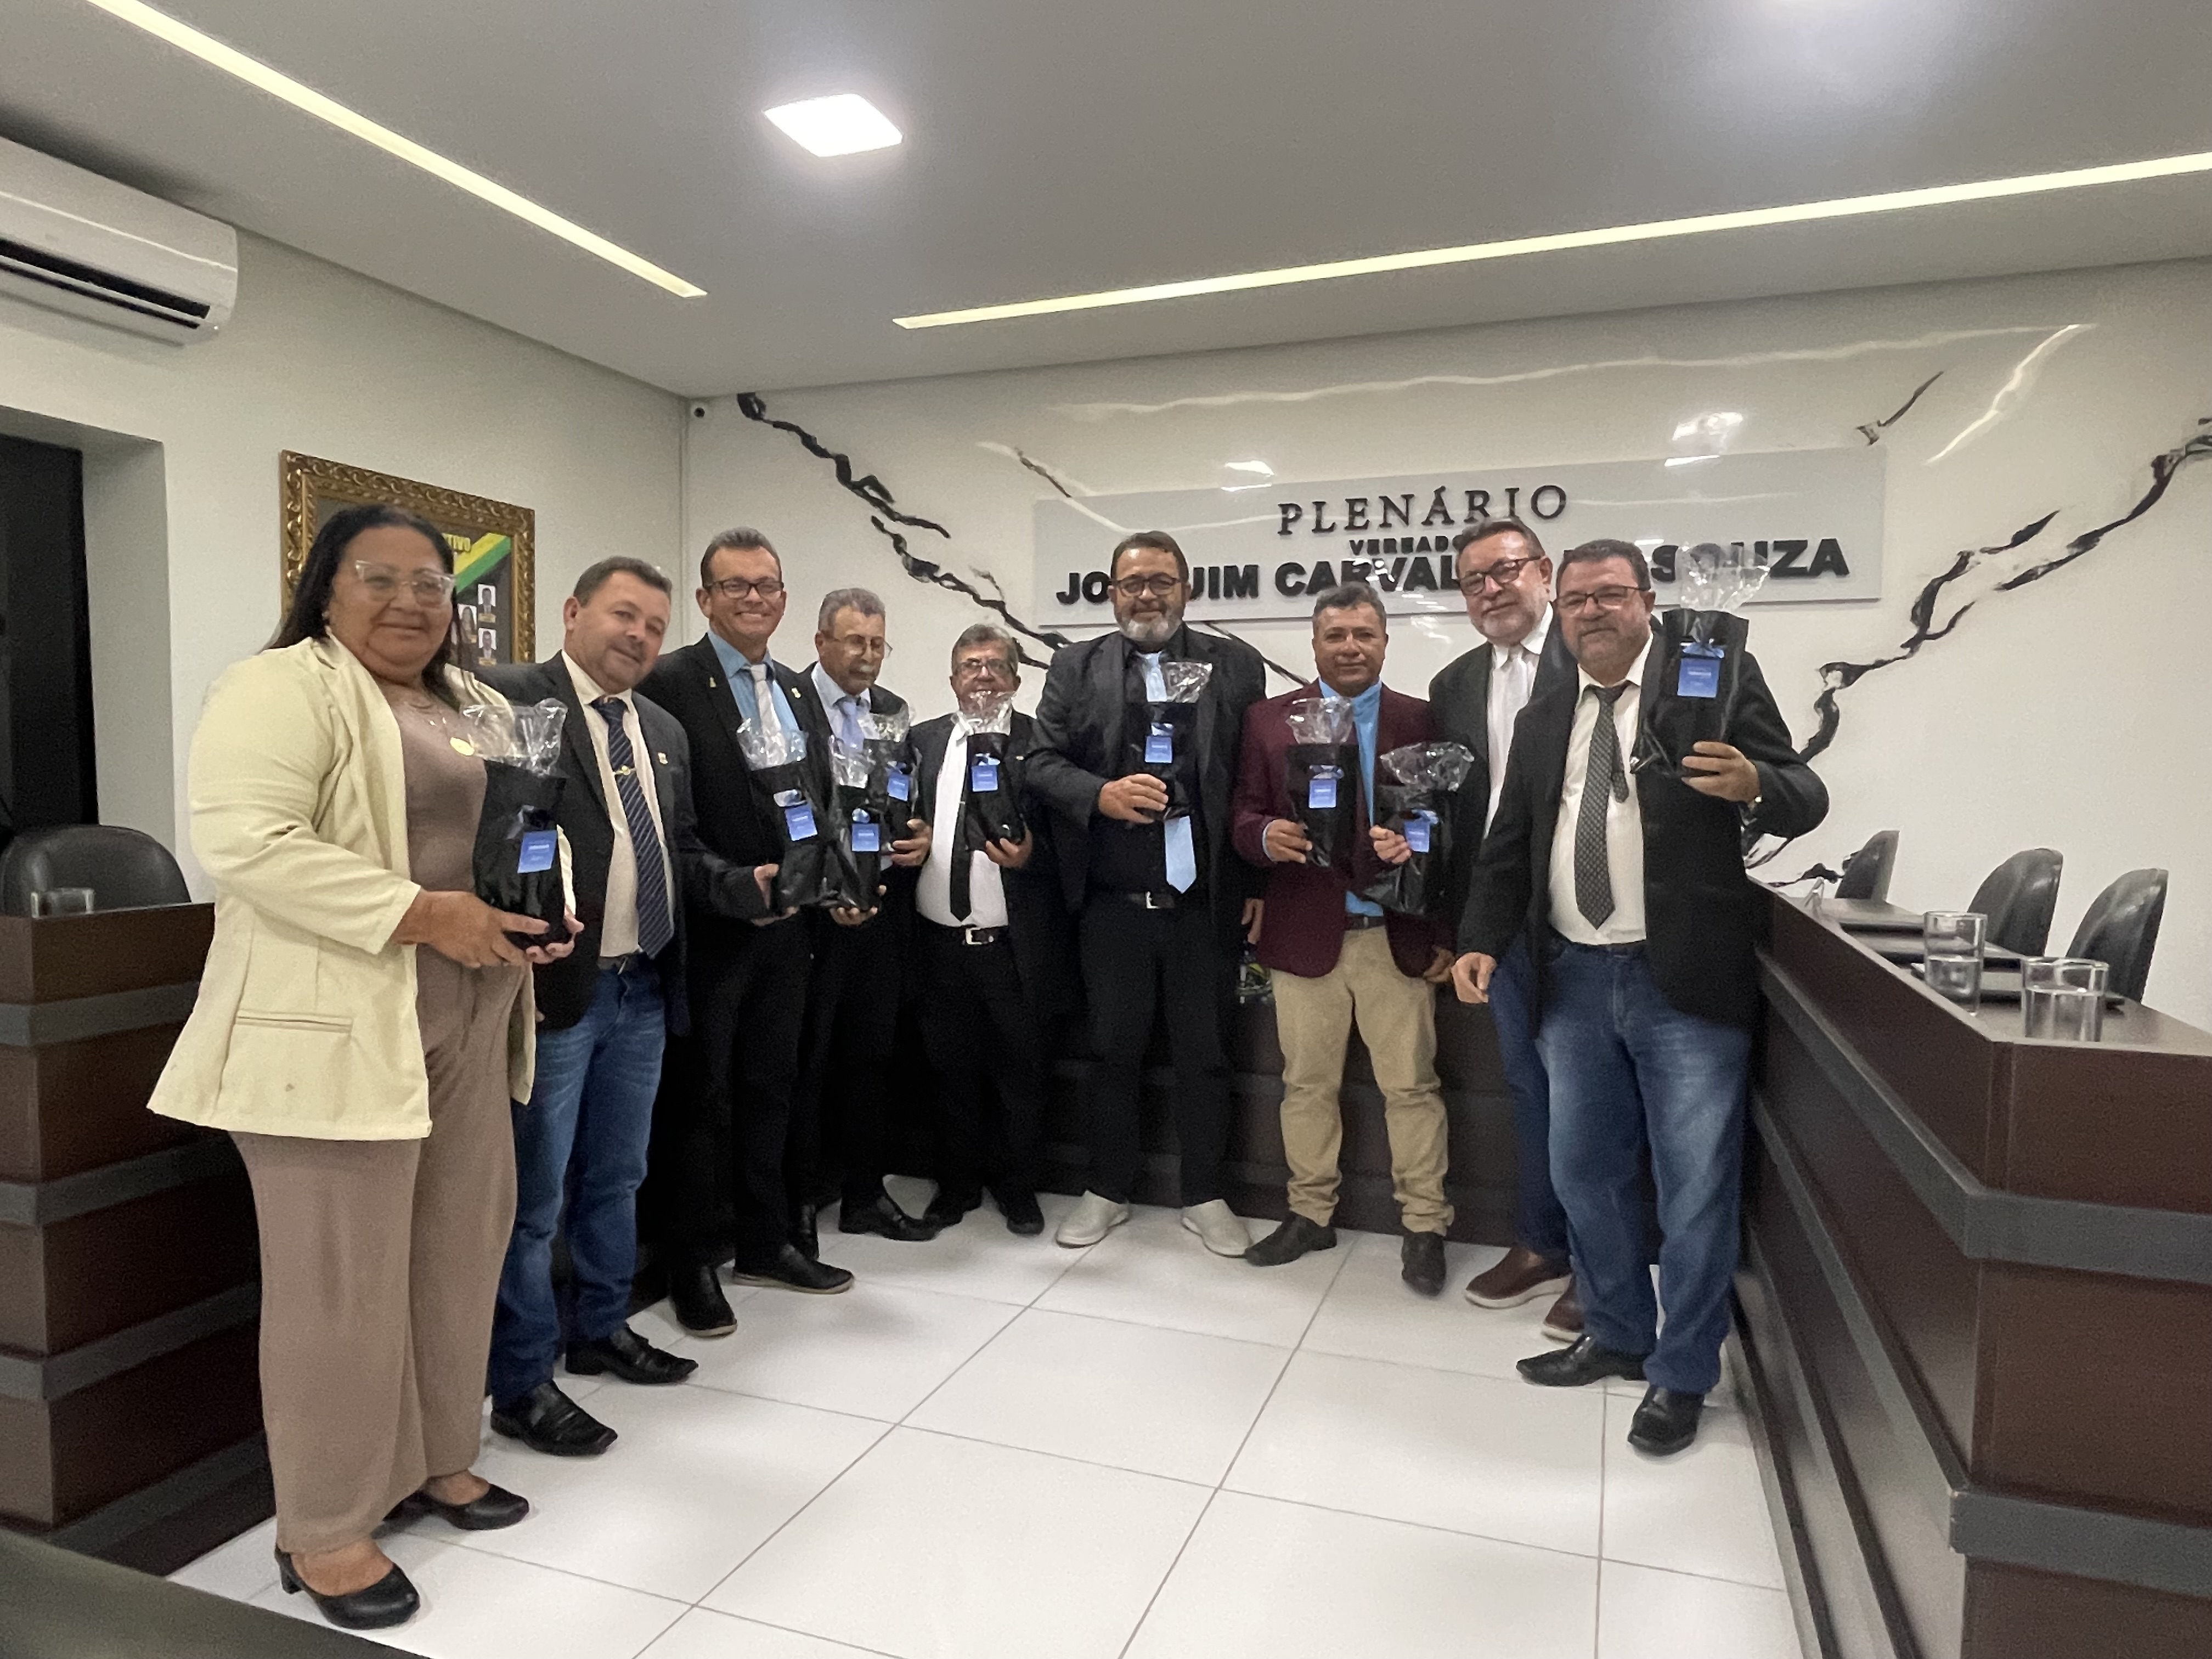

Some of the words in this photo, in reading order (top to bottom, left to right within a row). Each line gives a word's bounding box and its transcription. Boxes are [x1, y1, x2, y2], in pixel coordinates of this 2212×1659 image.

[1277, 485, 1567, 535] PLENÁRIO
[1348, 535, 1464, 555] VEREADO
[1056, 565, 1259, 605] JOUIM
[1275, 555, 1462, 597] CARVAL
